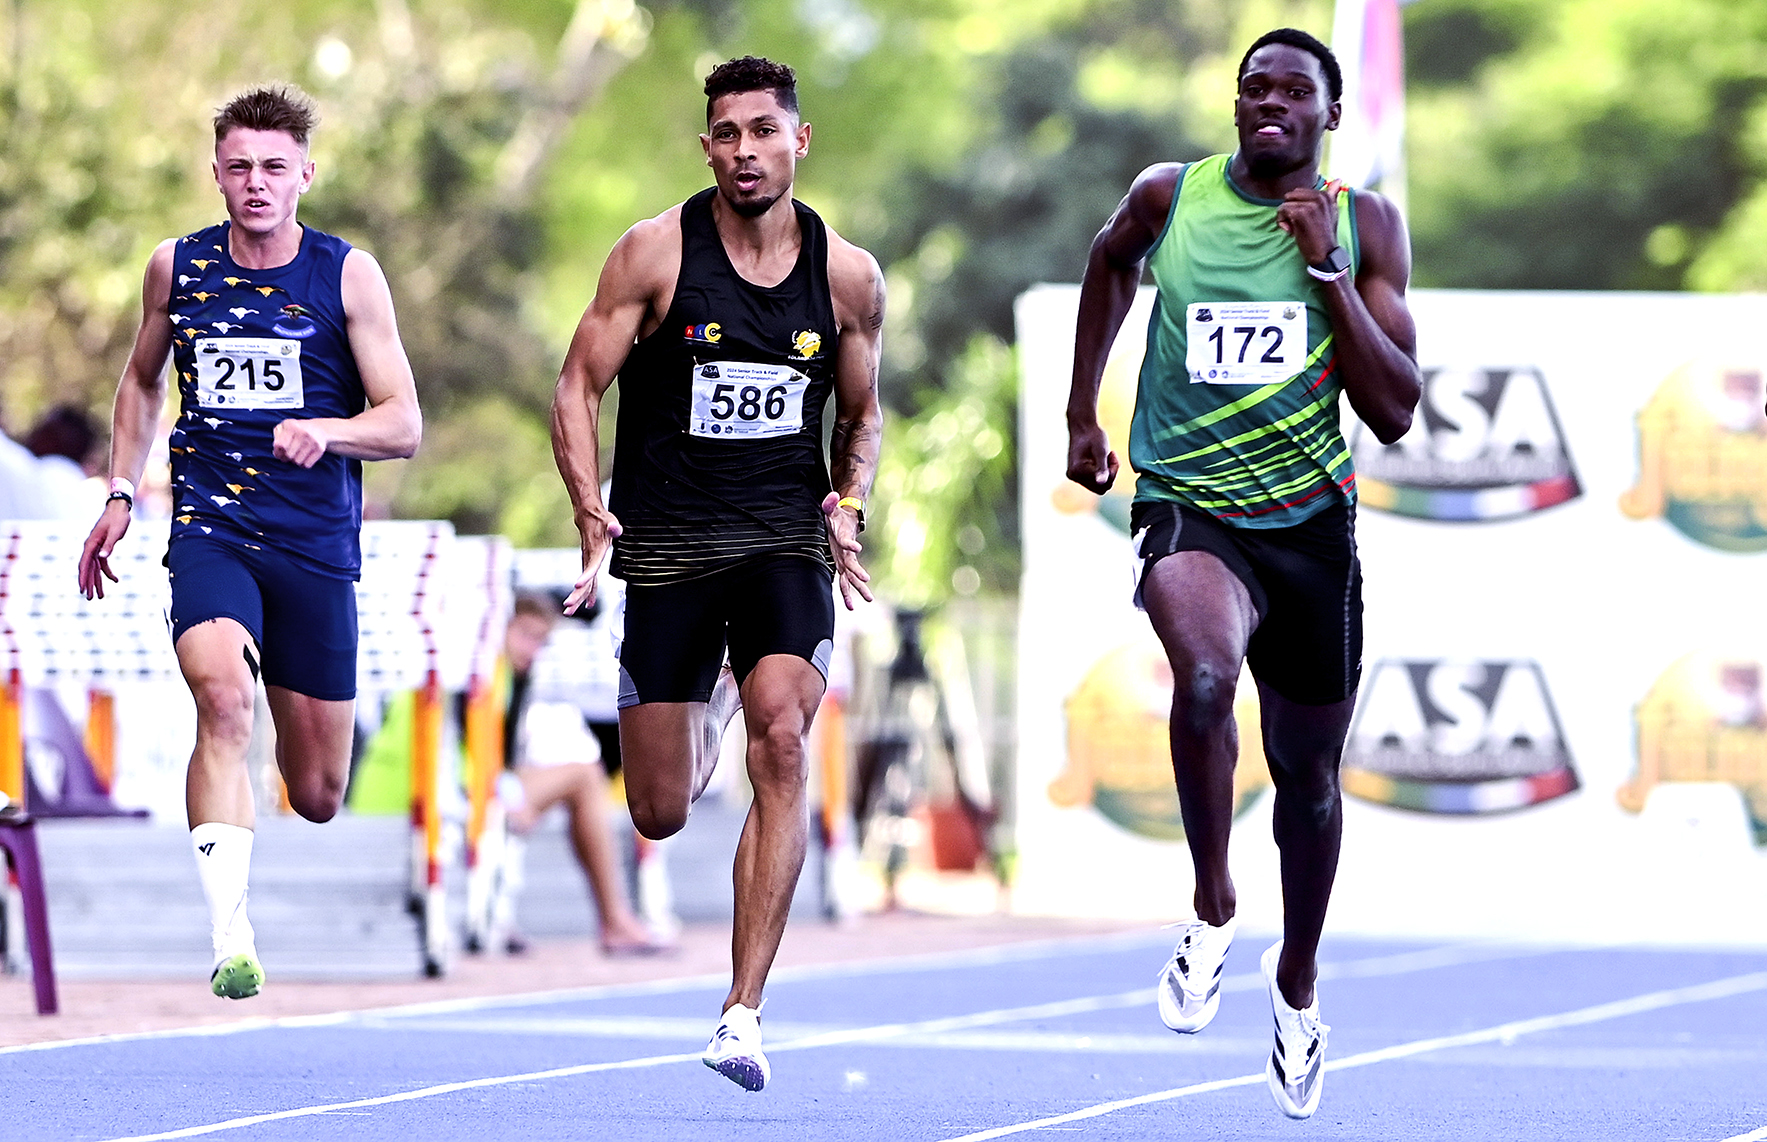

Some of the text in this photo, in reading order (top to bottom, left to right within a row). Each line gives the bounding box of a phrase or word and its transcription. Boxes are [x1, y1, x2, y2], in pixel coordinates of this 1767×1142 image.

[1208, 326, 1284, 364] 172
[214, 357, 285, 391] 215
[703, 365, 718, 374] ASA
[710, 383, 788, 420] 586
[1353, 657, 1558, 756] ASA
